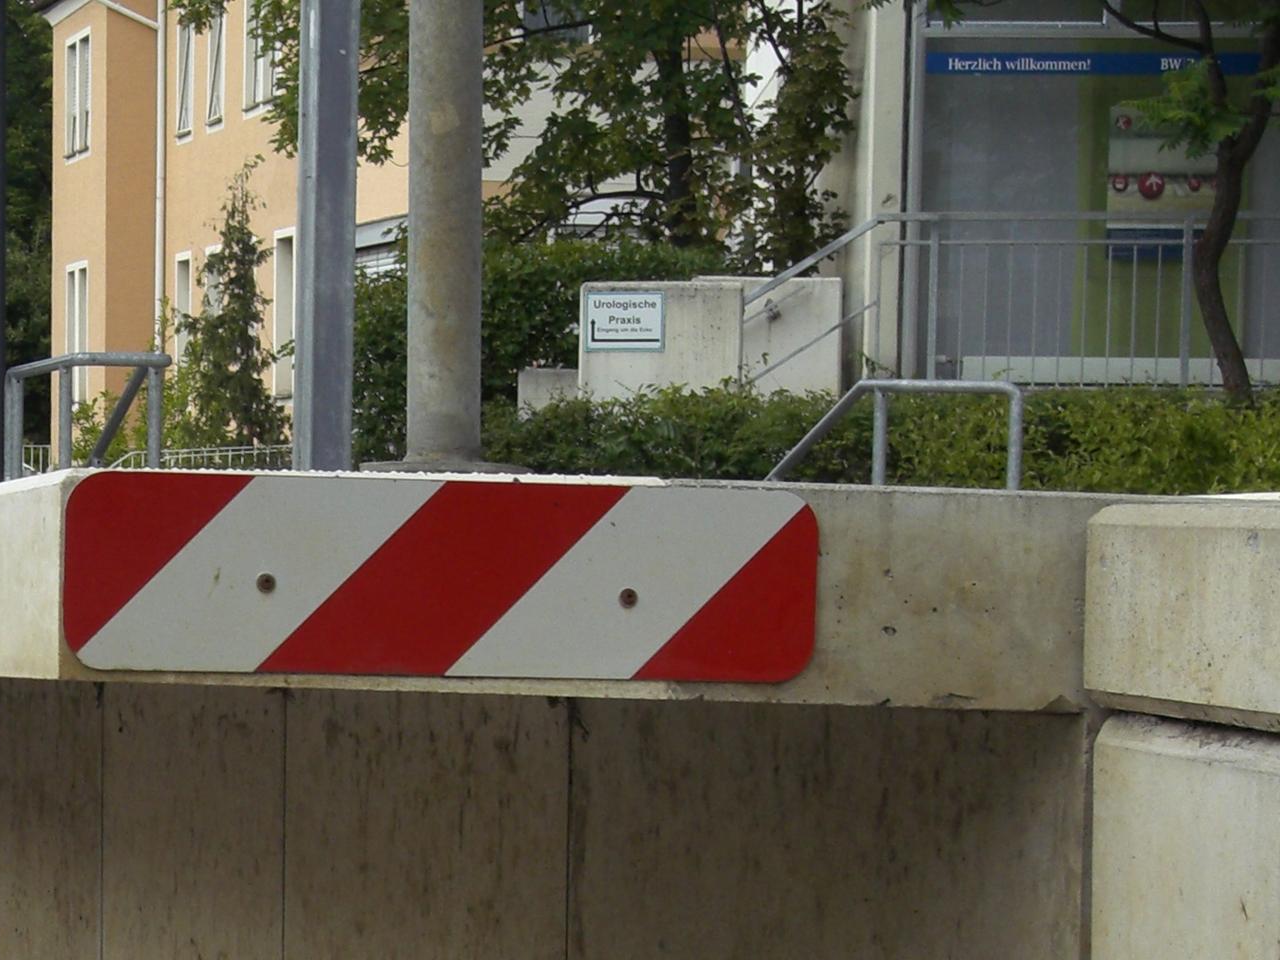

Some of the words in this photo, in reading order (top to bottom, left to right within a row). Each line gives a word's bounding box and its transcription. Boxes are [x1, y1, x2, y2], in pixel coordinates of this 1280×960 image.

[948, 57, 1001, 71] Herzlich
[1005, 57, 1091, 71] willkommen!
[593, 300, 657, 311] Urologische
[608, 315, 641, 325] Praxis
